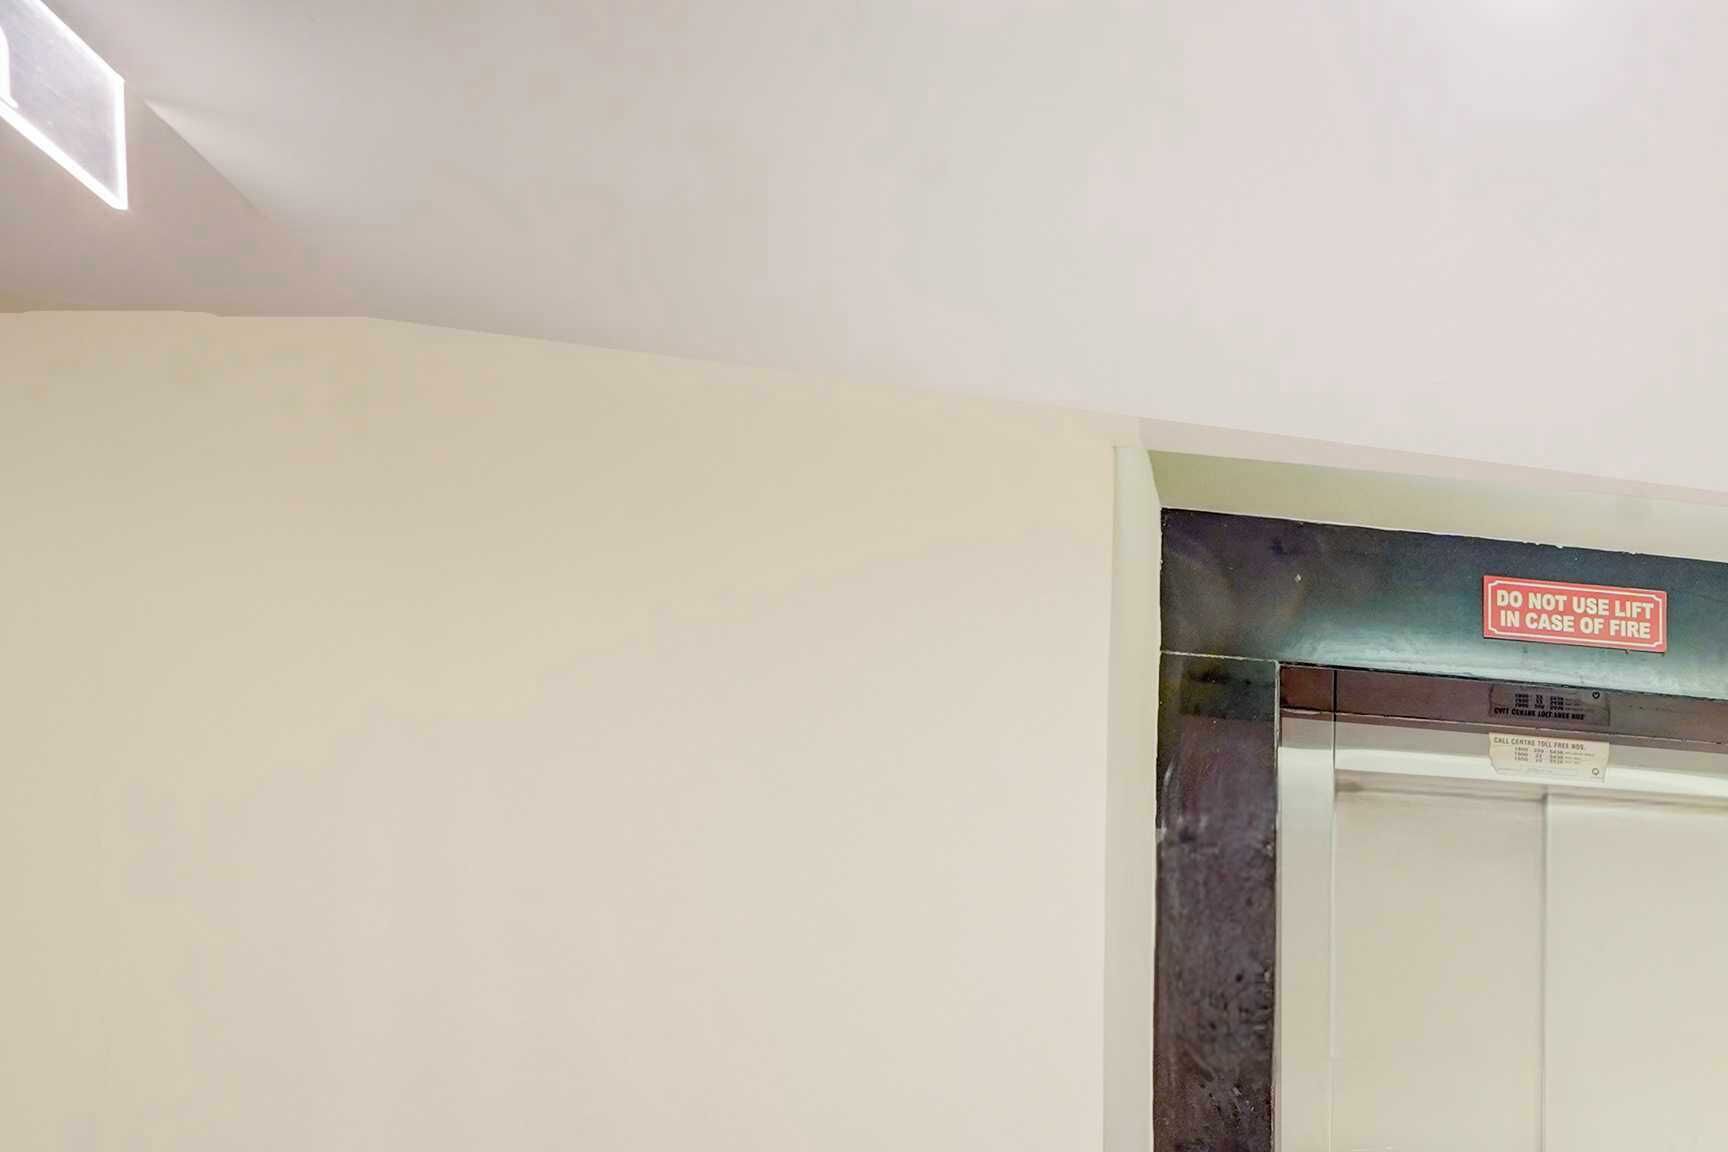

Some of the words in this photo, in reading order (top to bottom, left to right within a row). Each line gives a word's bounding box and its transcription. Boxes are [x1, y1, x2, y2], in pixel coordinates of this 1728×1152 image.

[1496, 589, 1523, 608] DO
[1528, 592, 1567, 612] NOT
[1572, 596, 1610, 616] USE
[1615, 600, 1654, 619] LIFT
[1500, 610, 1520, 628] IN
[1525, 612, 1575, 633] CASE
[1580, 617, 1604, 635] OF
[1609, 620, 1651, 639] FIRE
